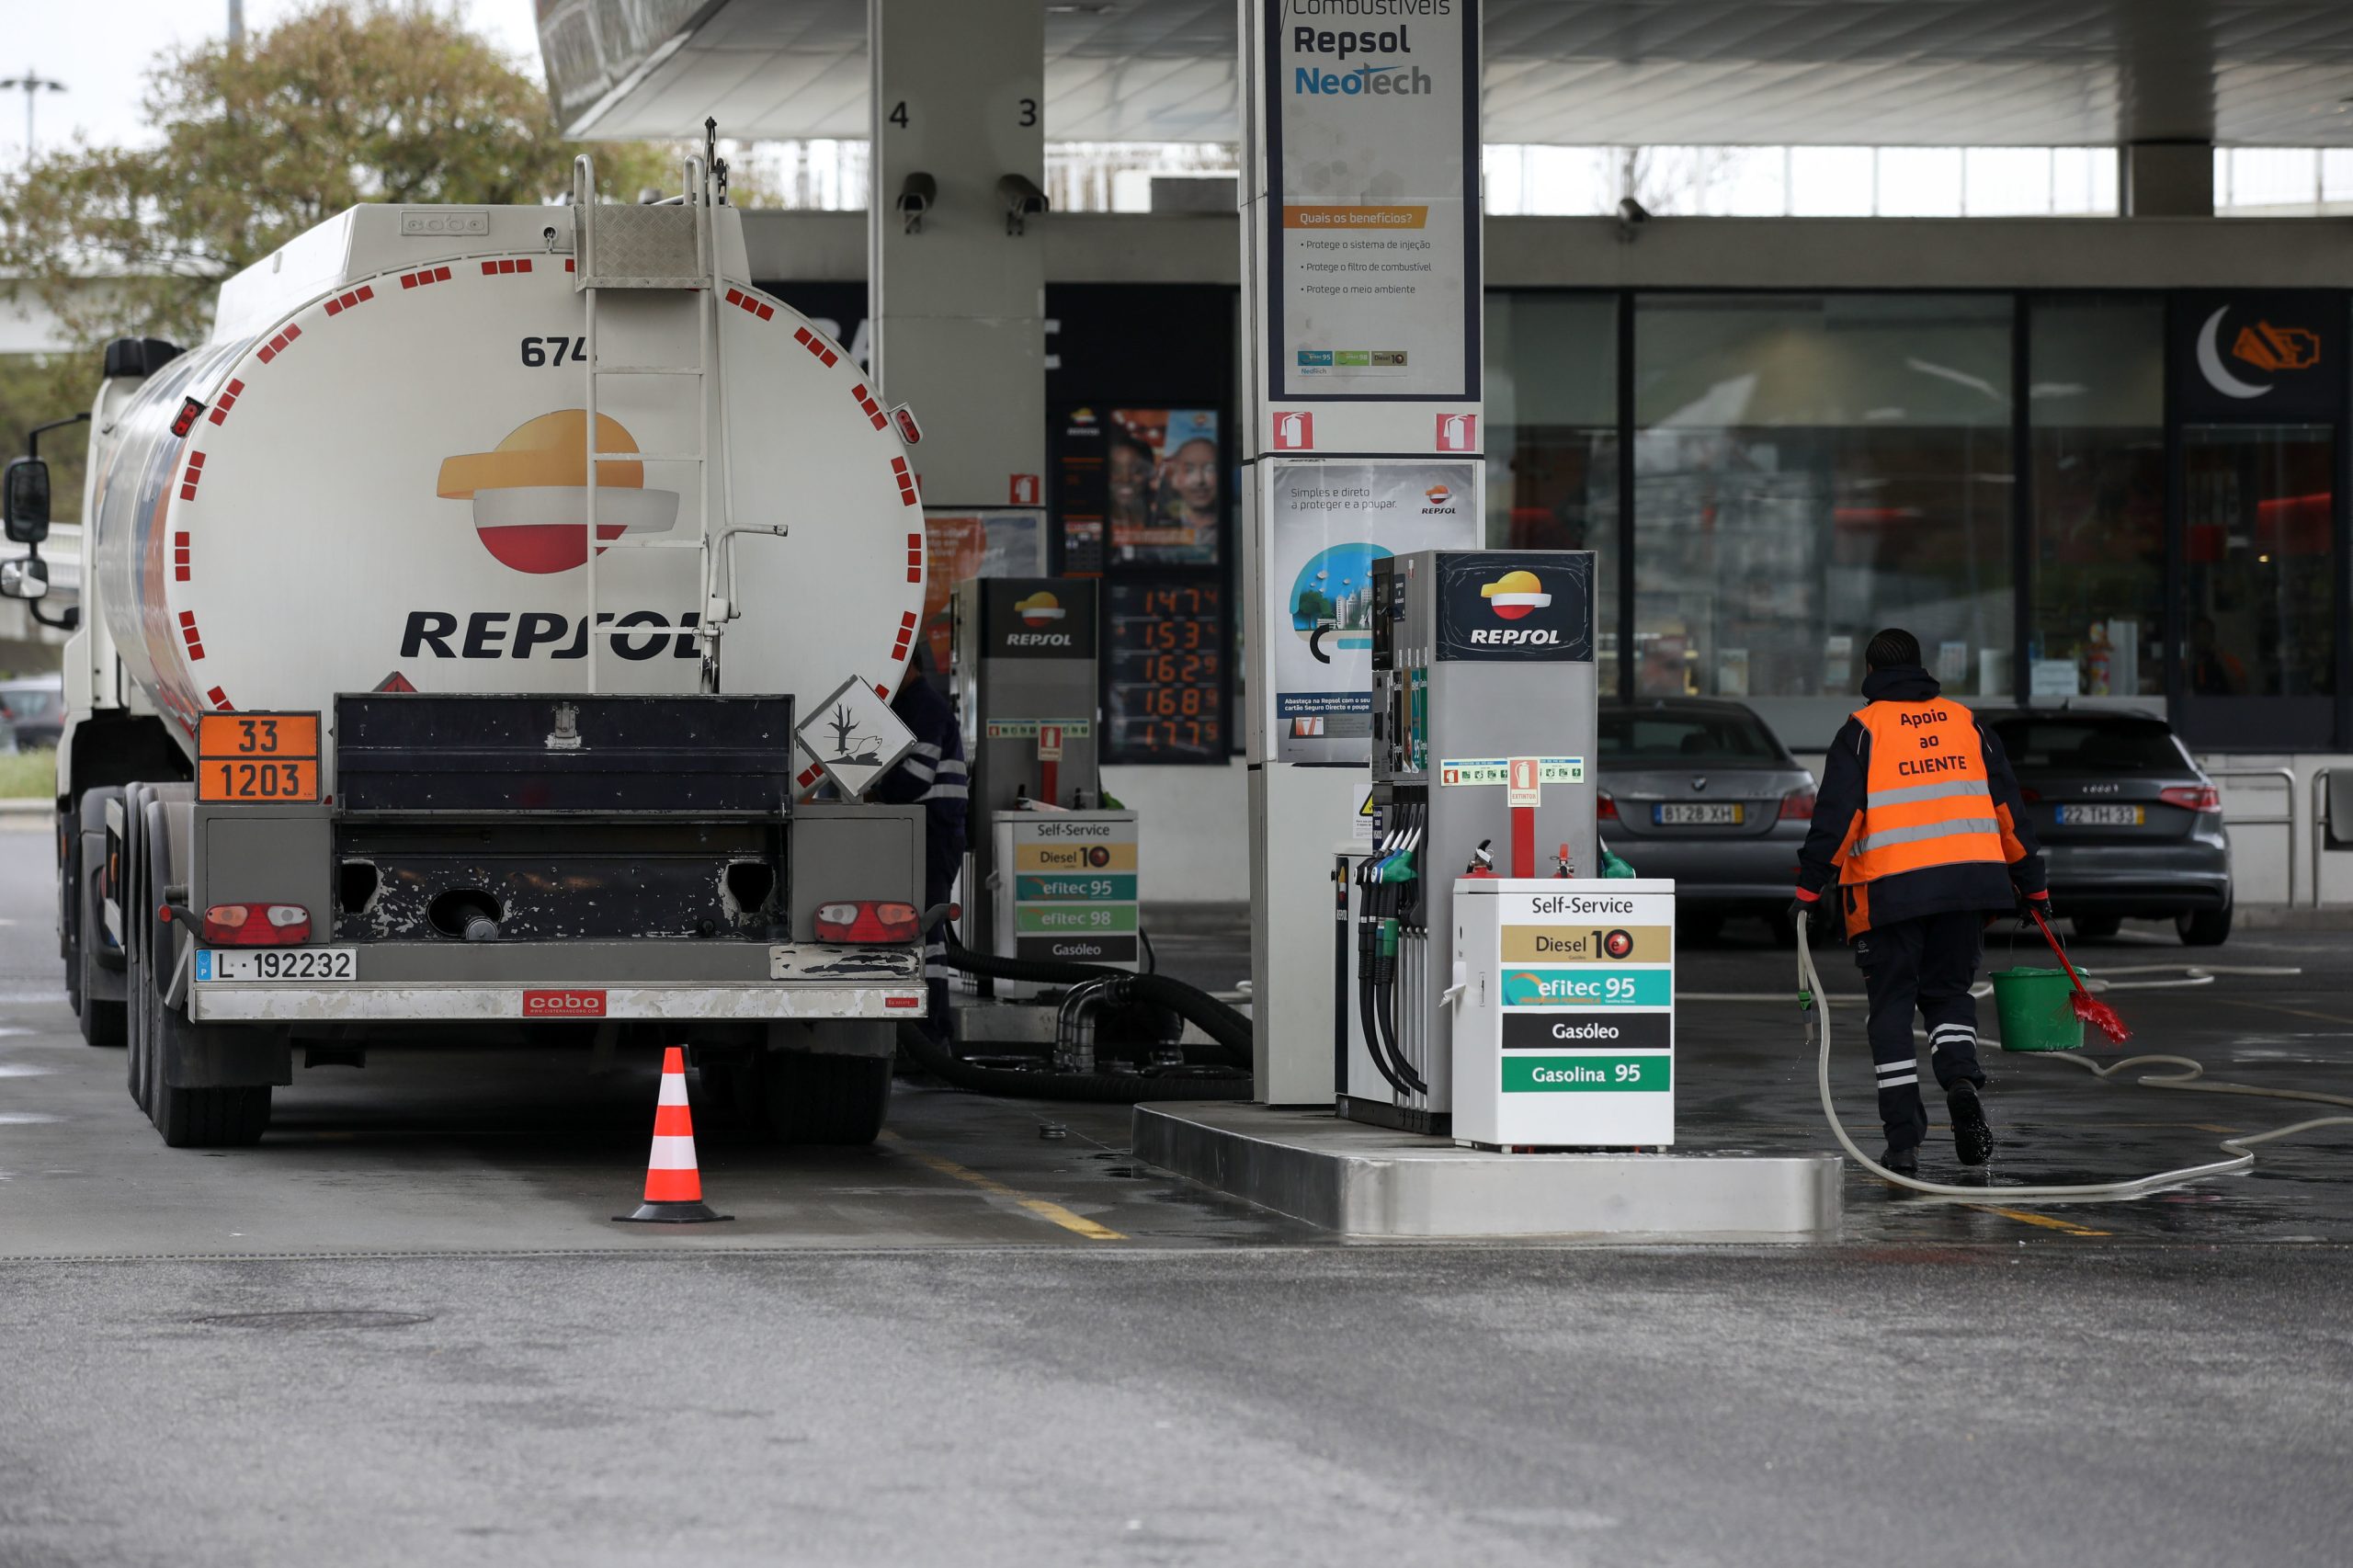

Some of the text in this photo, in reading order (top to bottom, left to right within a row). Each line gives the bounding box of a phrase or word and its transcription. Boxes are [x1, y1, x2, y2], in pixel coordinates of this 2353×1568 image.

[1294, 25, 1411, 60] Repsol
[889, 101, 909, 129] 4
[1018, 98, 1038, 127] 3
[1300, 212, 1413, 224] Quais os benefícios?
[1306, 241, 1340, 251] Protege
[1350, 241, 1385, 249] sistema
[1387, 241, 1398, 249] de
[1400, 241, 1431, 251] injeção
[1306, 263, 1339, 273] Protege
[1347, 263, 1368, 271] filtro
[1369, 263, 1380, 271] de
[1381, 262, 1432, 271] combustível
[1306, 286, 1341, 296] Protege
[1350, 285, 1372, 294] meio
[1374, 285, 1415, 294] ambiente
[1290, 487, 1370, 498] Simples e direto
[1300, 500, 1341, 511] proteger
[1353, 501, 1359, 509] a
[1361, 499, 1397, 510] poupar.
[400, 611, 702, 660] REPSOL
[1006, 633, 1072, 645] REPSOL
[1471, 629, 1561, 644] REPSOL
[1901, 709, 1948, 728] Apoio
[238, 720, 278, 752] 33
[1919, 735, 1938, 749] ao
[1898, 756, 1967, 776] CLIENTE
[221, 764, 299, 797] 1203
[1038, 824, 1110, 836] Self-Service
[1040, 846, 1110, 868] Diesel 10
[1043, 881, 1112, 895] efitec 95
[1531, 896, 1633, 914] Self-Service
[1041, 911, 1111, 926] efitec 98
[1052, 943, 1101, 956] Gasóleo
[1536, 928, 1634, 960] Diesel 10
[200, 968, 207, 976] P
[1538, 977, 1635, 998] efitec 95
[529, 994, 599, 1008] cobo
[1552, 1022, 1620, 1039] Gasóleo
[1532, 1064, 1641, 1083] Gasolina 95
